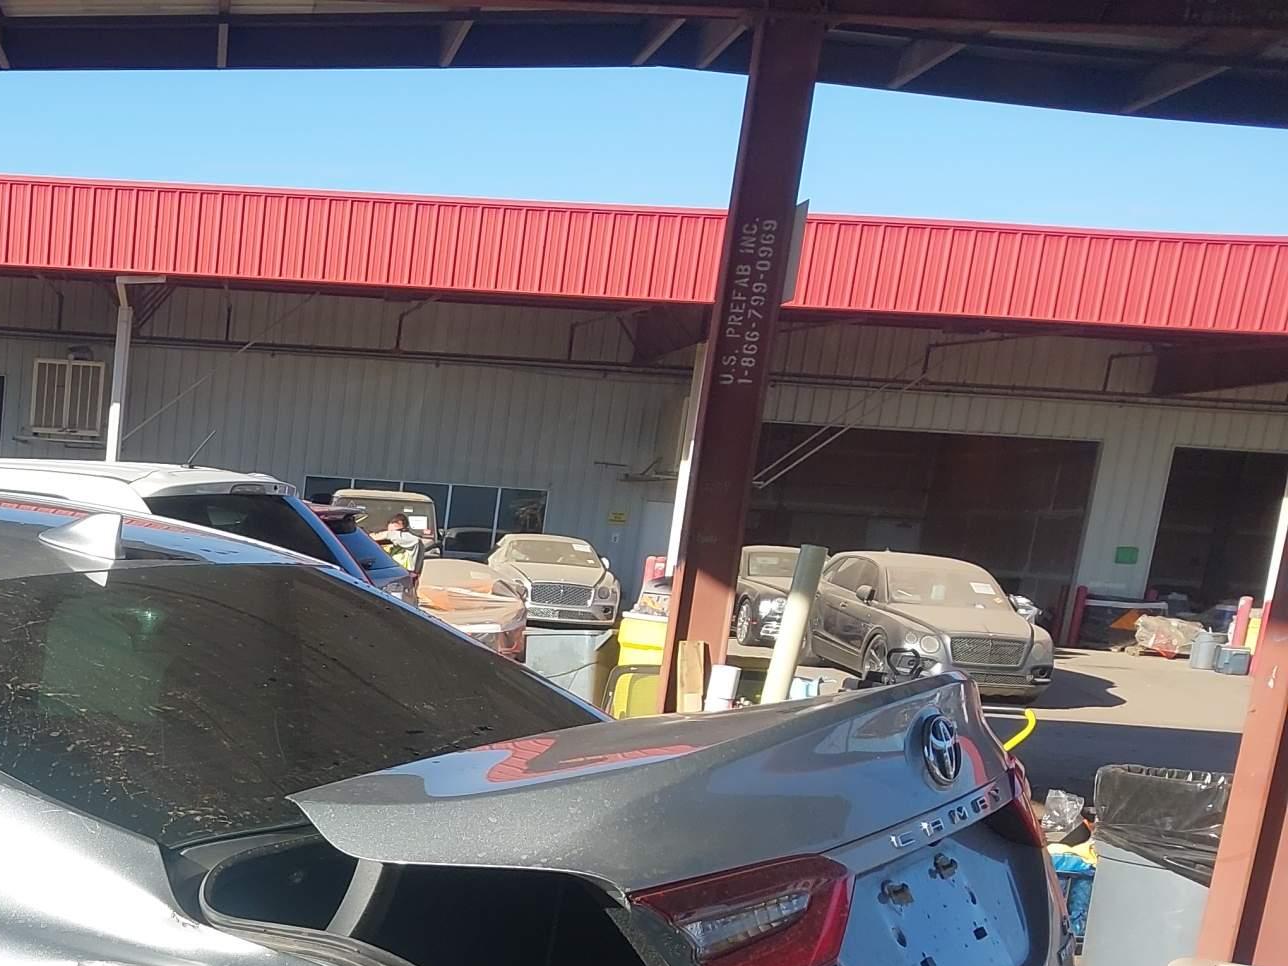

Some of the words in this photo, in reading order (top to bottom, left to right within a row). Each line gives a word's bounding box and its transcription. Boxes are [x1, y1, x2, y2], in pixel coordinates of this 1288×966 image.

[741, 217, 760, 254] INC.
[725, 264, 751, 338] PREFAB
[737, 219, 778, 384] 1-866-799-0969
[720, 350, 739, 385] U.S.
[890, 785, 1001, 848] CAMRY
